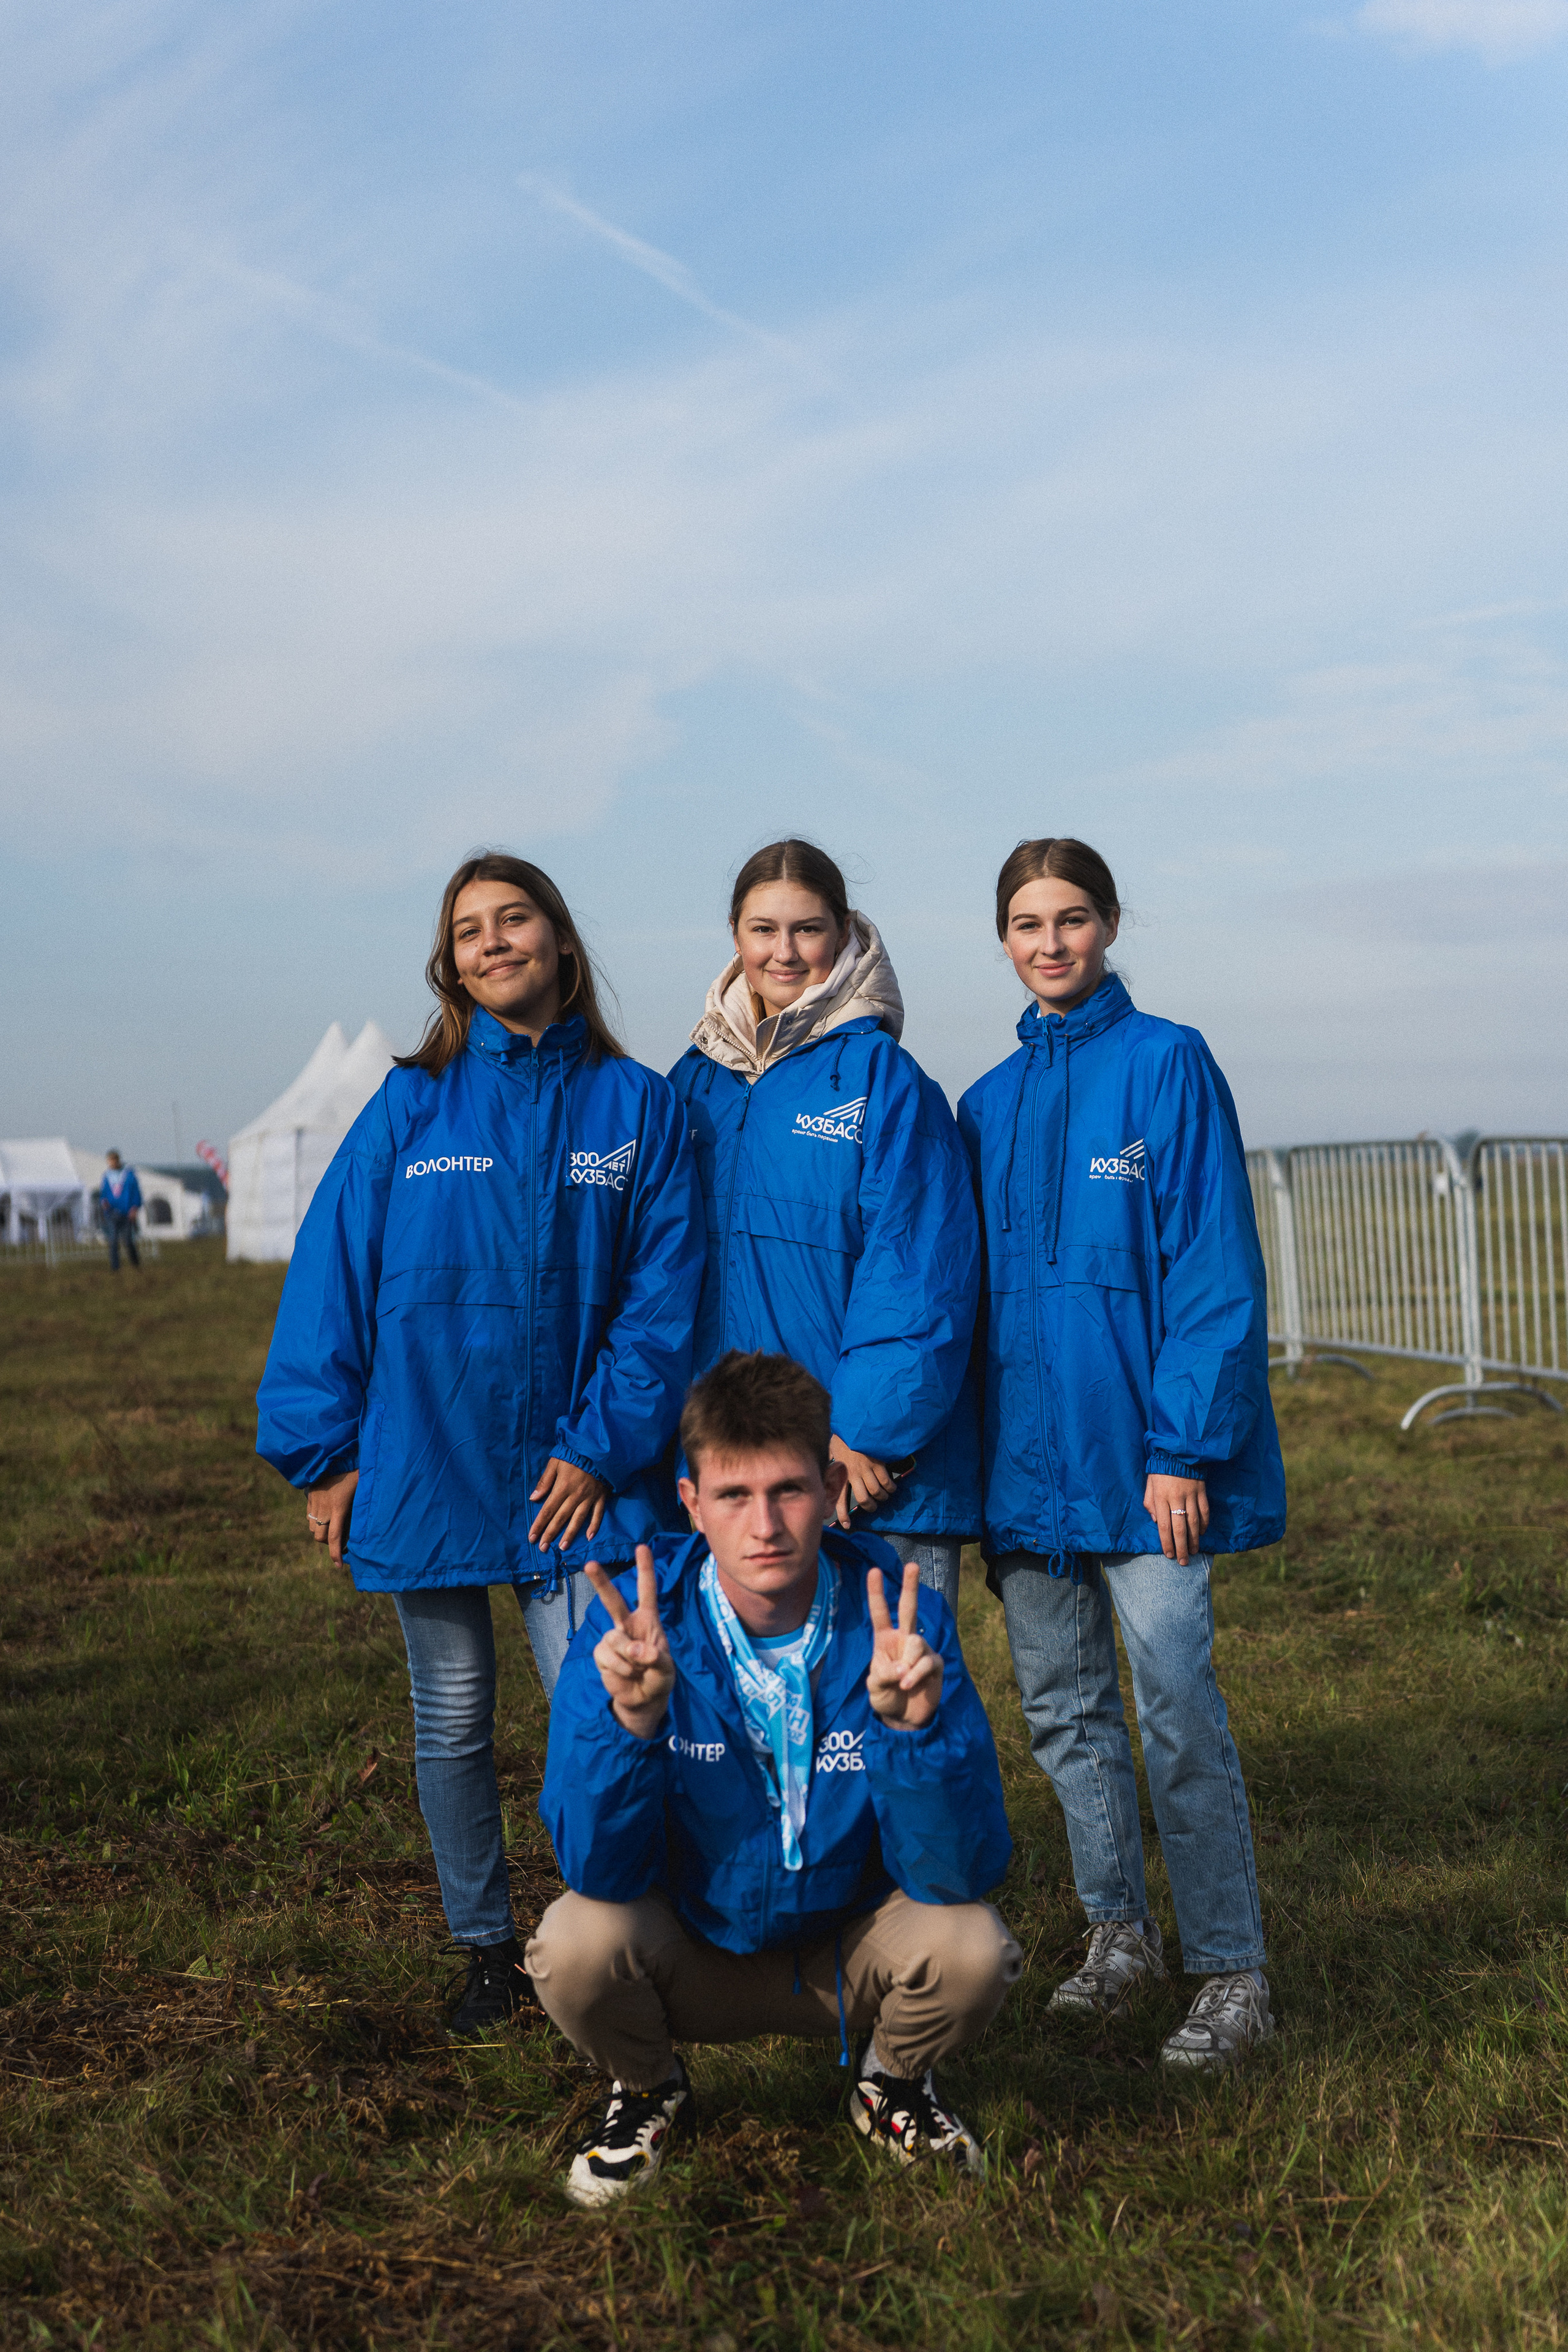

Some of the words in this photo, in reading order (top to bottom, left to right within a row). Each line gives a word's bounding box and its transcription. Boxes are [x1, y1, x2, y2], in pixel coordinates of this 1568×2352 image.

[796, 1113, 864, 1144] КУЗБАСС
[405, 1156, 494, 1179] ВОЛОНТЕР
[570, 1152, 600, 1167] 300
[602, 1161, 625, 1172] ЛЕТ
[569, 1168, 628, 1191] КУЗБАС
[818, 1730, 854, 1754] 300
[816, 1752, 866, 1773] КУЗБ
